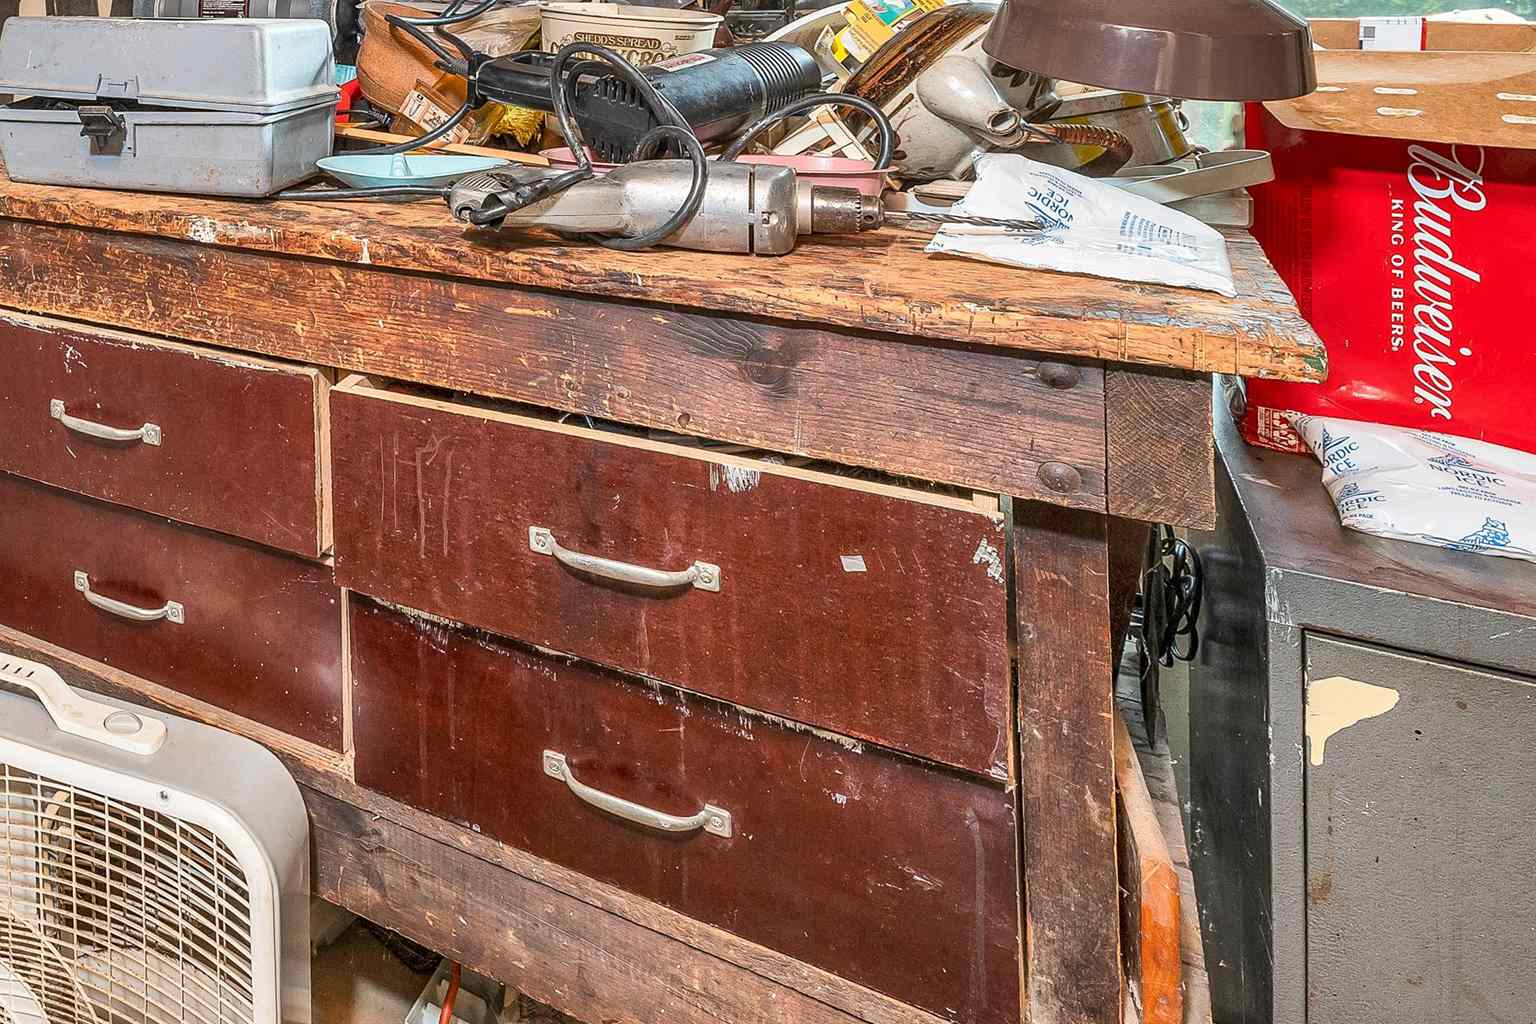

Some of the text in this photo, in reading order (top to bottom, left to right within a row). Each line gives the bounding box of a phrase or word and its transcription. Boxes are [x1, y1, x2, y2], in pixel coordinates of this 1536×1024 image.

[575, 33, 660, 49] SHEDD'S SPREAD
[1045, 187, 1069, 208] ICE
[1390, 198, 1405, 349] KING OF BEERS
[1407, 143, 1488, 420] Budweiser
[1322, 440, 1360, 469] ORDIC
[1330, 459, 1356, 476] ICE
[1428, 463, 1507, 488] NORDIC
[1337, 493, 1388, 510] ORDIC
